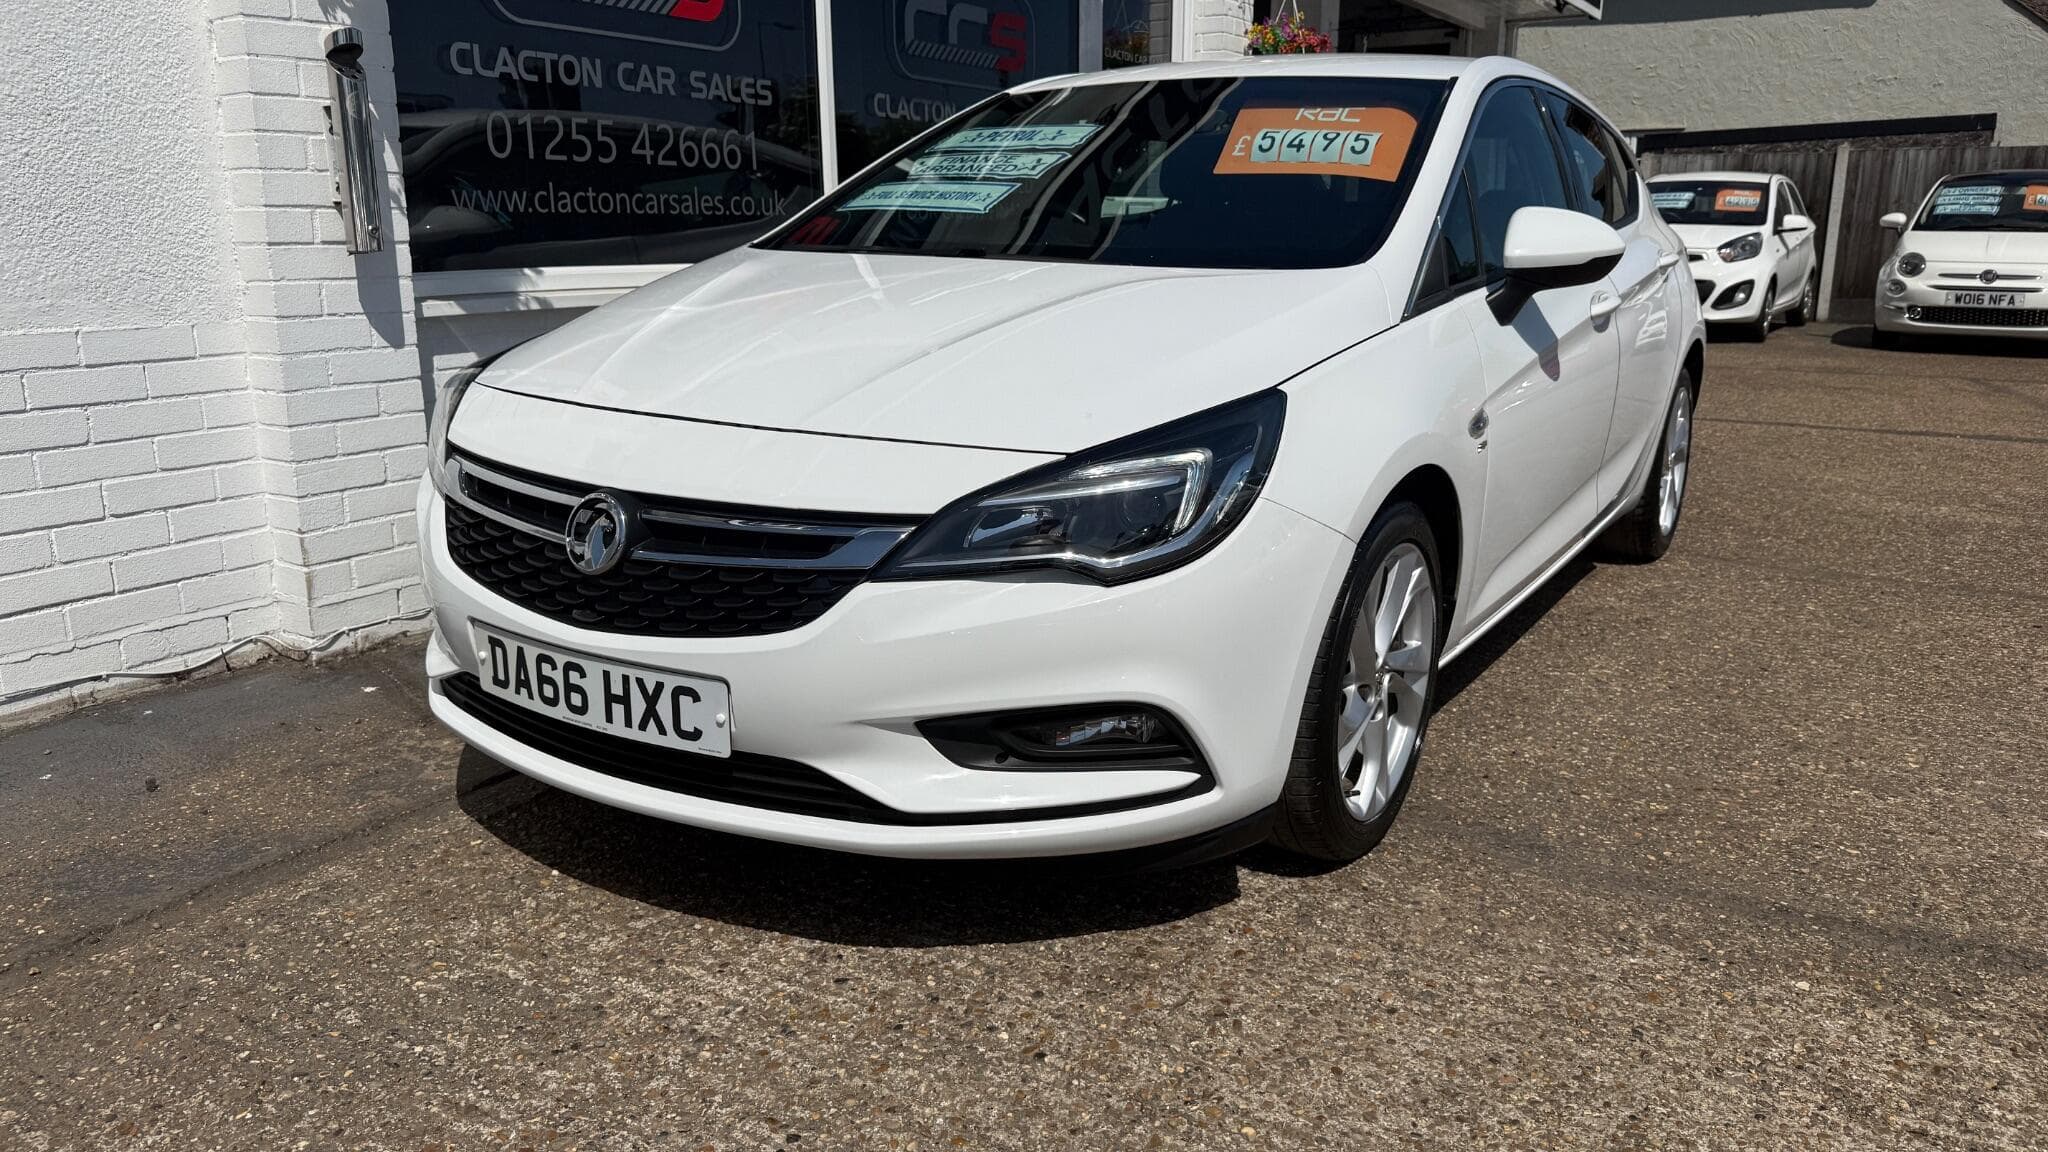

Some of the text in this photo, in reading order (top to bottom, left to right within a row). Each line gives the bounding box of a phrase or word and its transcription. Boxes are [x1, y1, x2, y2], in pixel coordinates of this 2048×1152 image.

[450, 41, 773, 106] CLACTON CAR SALES
[486, 111, 758, 171] 01255 426661
[979, 129, 1042, 143] PETROL
[941, 155, 1018, 164] FINANCE
[451, 182, 787, 217] www.clactoncarsales.co.uk
[876, 191, 982, 201] FULL SERVICE HISTORY
[1988, 294, 2016, 306] NFA
[488, 635, 704, 743] DA66 HXC
